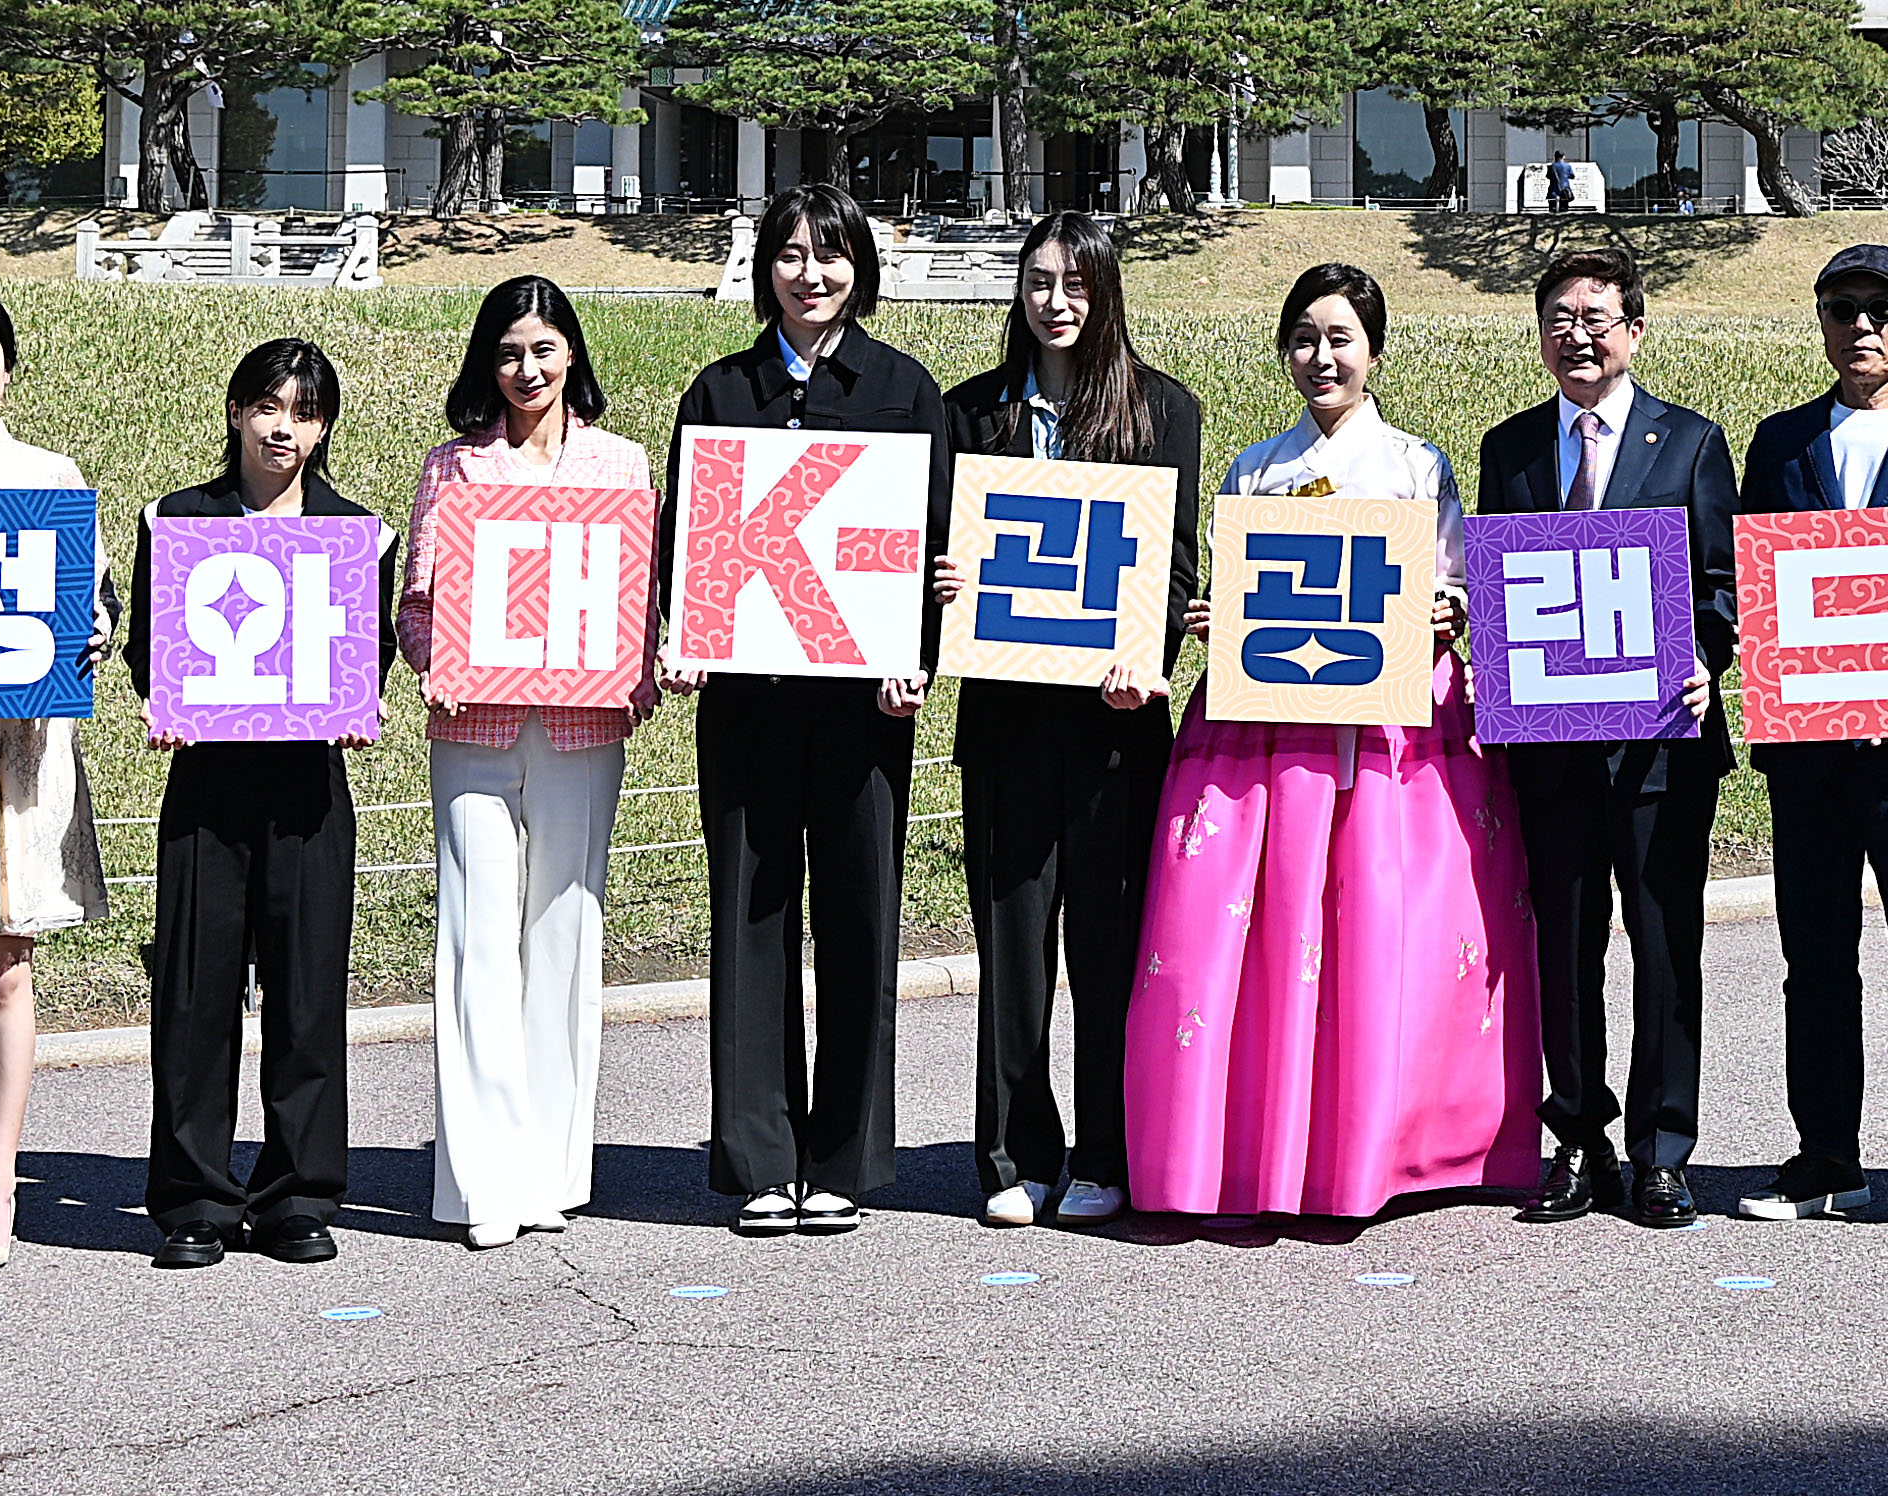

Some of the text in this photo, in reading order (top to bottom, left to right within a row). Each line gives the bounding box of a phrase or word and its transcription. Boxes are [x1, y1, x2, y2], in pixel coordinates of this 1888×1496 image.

[183, 553, 345, 705] 와
[469, 519, 621, 670] 대
[975, 493, 1137, 649] 관
[1243, 534, 1401, 685] 광
[1503, 547, 1658, 705] 랜
